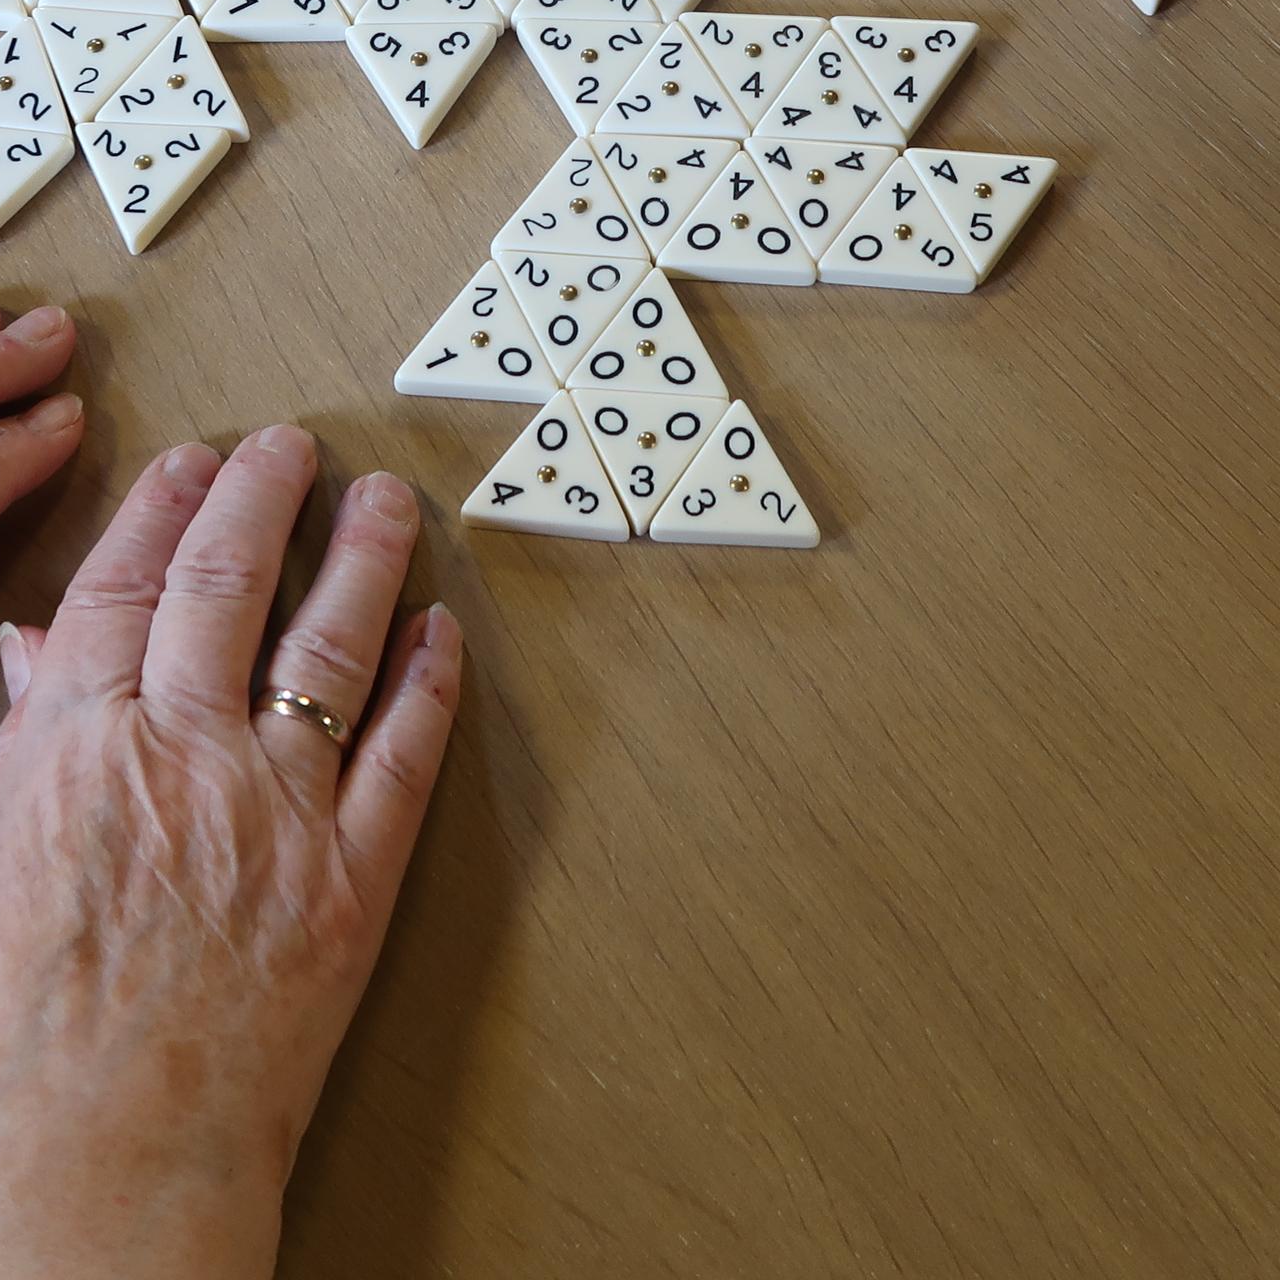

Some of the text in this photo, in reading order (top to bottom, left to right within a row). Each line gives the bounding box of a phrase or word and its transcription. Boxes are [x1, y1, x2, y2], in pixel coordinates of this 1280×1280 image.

[369, 32, 403, 58] 5
[438, 31, 471, 56] 3
[539, 27, 572, 51] 3
[608, 27, 644, 52] 2
[700, 19, 734, 46] 2
[772, 24, 804, 48] 3
[855, 26, 888, 49] 3
[924, 29, 957, 53] 3
[659, 42, 683, 70] 2
[818, 51, 842, 79] 3
[73, 67, 99, 94] 2
[405, 79, 430, 108] 4
[575, 76, 600, 105] 2
[740, 71, 765, 99] 4
[893, 75, 918, 104] 4
[18, 92, 52, 121] 2
[119, 88, 155, 113] 2
[192, 89, 227, 117] 2
[616, 94, 652, 120] 2
[693, 94, 722, 120] 4
[781, 106, 812, 127] 4
[852, 104, 882, 129] 4
[6, 137, 43, 162] 2
[92, 129, 127, 157] 2
[164, 133, 201, 159] 2
[604, 142, 638, 171] 2
[676, 149, 706, 169] 4
[764, 145, 793, 171] 4
[834, 151, 865, 171] 4
[929, 159, 959, 185] 4
[569, 158, 593, 187] 2
[729, 171, 755, 201] 4
[1000, 164, 1031, 185] 4
[123, 184, 150, 214] 2
[891, 182, 917, 212] 4
[521, 212, 557, 237] 2
[640, 196, 670, 227] 0
[798, 198, 829, 229] 0
[595, 215, 629, 242] 0
[686, 223, 721, 251] 0
[757, 227, 791, 255] 0
[969, 212, 994, 242] 5
[848, 234, 883, 262] 0
[920, 238, 955, 268] 5
[514, 257, 550, 288] 2
[586, 264, 621, 292] 0
[472, 286, 498, 318] 2
[632, 297, 663, 329] 0
[547, 314, 579, 347] 0
[425, 347, 459, 370] 1
[497, 347, 533, 377] 0
[589, 350, 625, 380] 0
[661, 355, 696, 385] 0
[536, 418, 568, 452] 0
[594, 406, 629, 436] 0
[665, 411, 701, 441] 0
[724, 426, 756, 461] 0
[491, 482, 525, 506] 4
[629, 465, 655, 498] 3
[564, 485, 600, 515] 3
[682, 488, 717, 517] 3
[760, 491, 797, 524] 2
